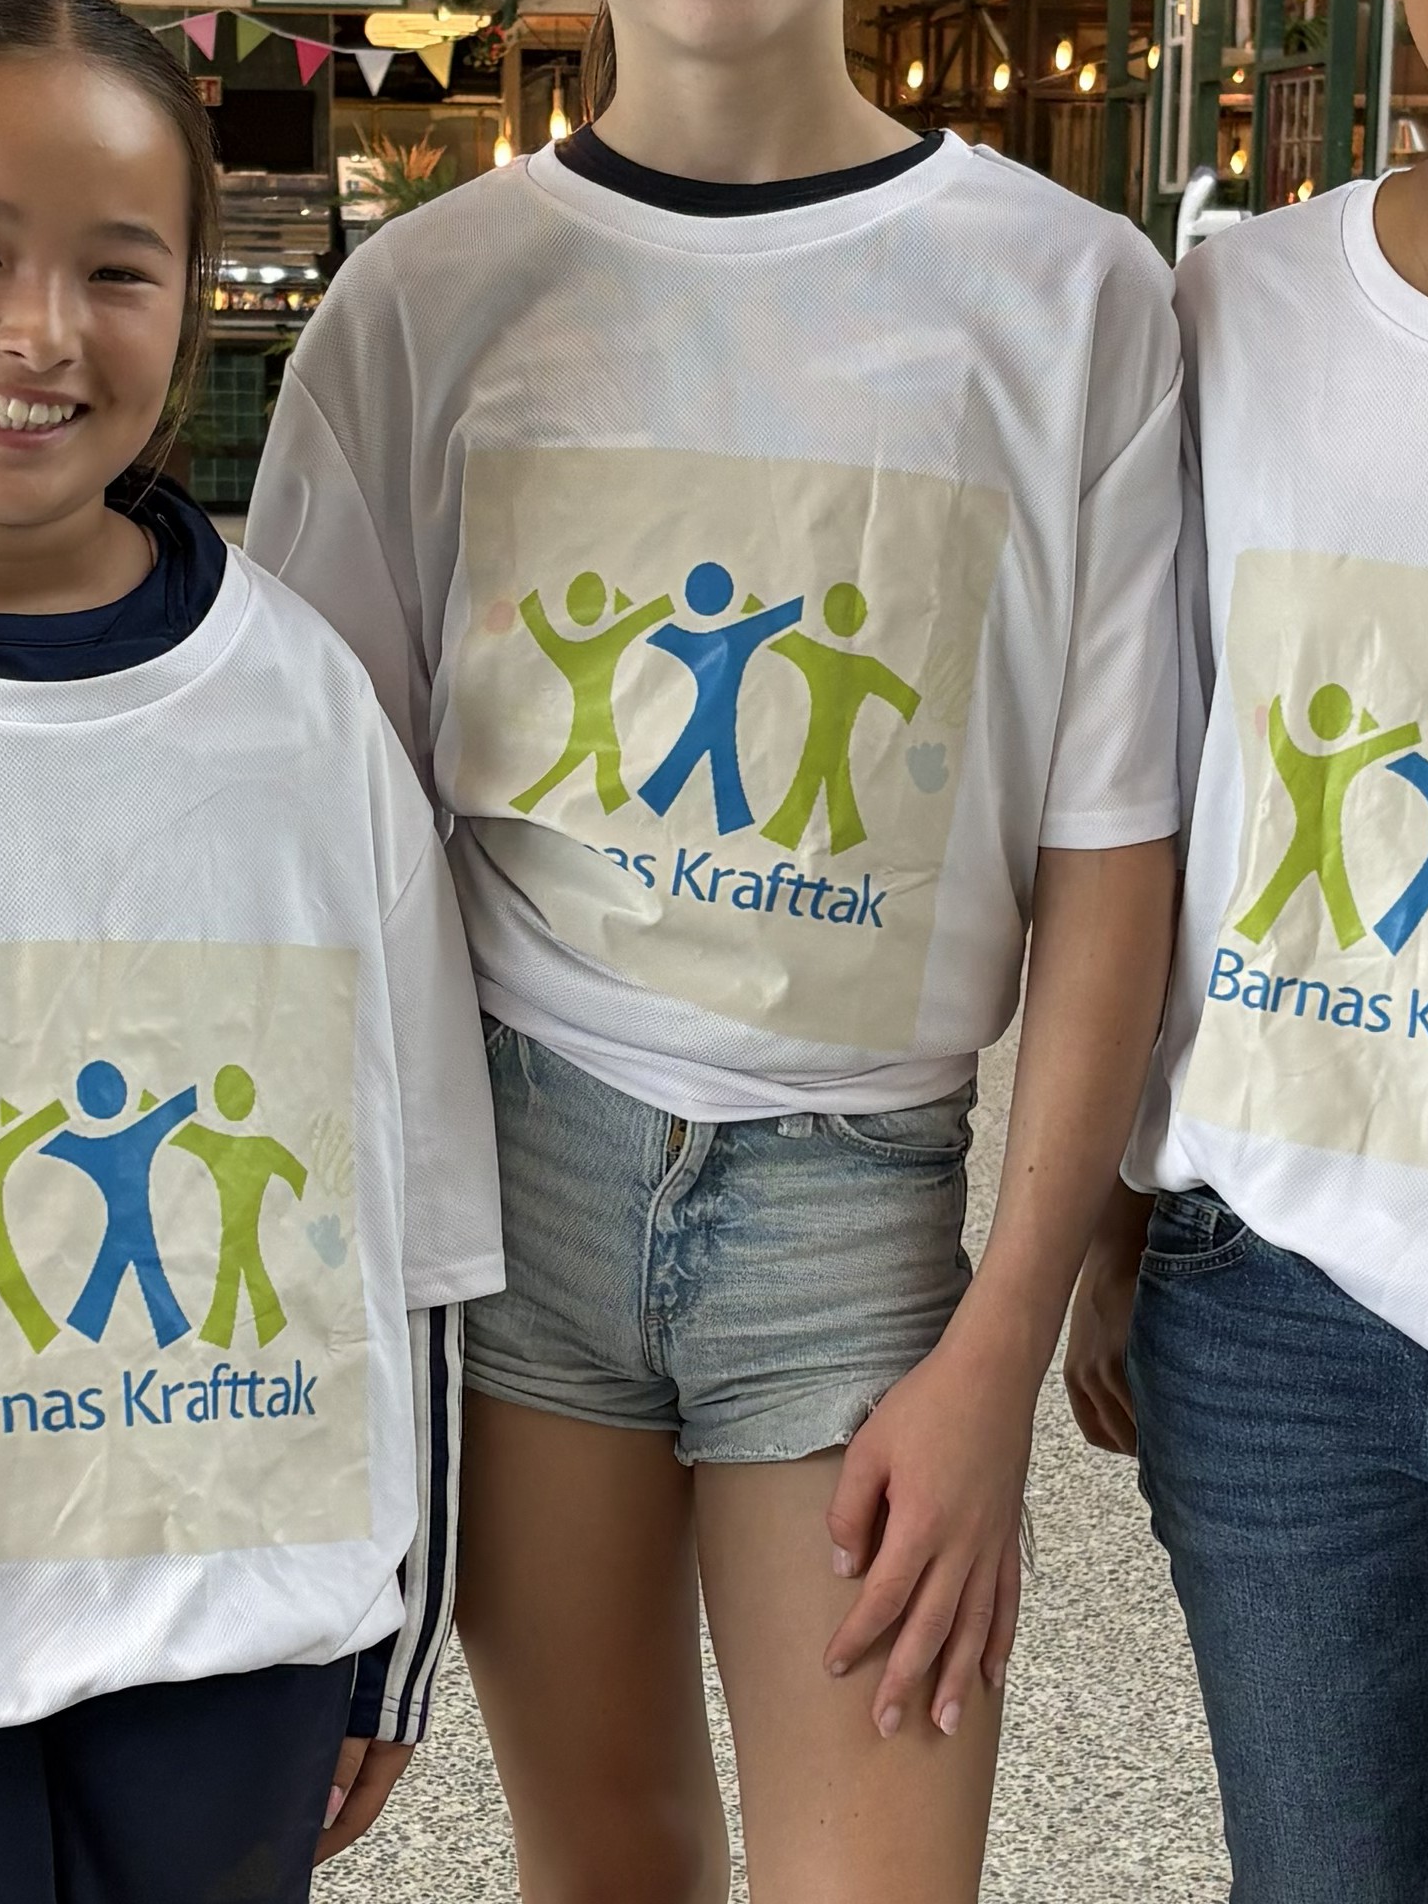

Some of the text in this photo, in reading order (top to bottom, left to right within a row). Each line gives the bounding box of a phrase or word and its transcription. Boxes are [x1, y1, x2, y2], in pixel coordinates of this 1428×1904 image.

[672, 847, 888, 928] Krafttak
[1207, 947, 1392, 1033] Barnas
[123, 1359, 318, 1427] Krafttak
